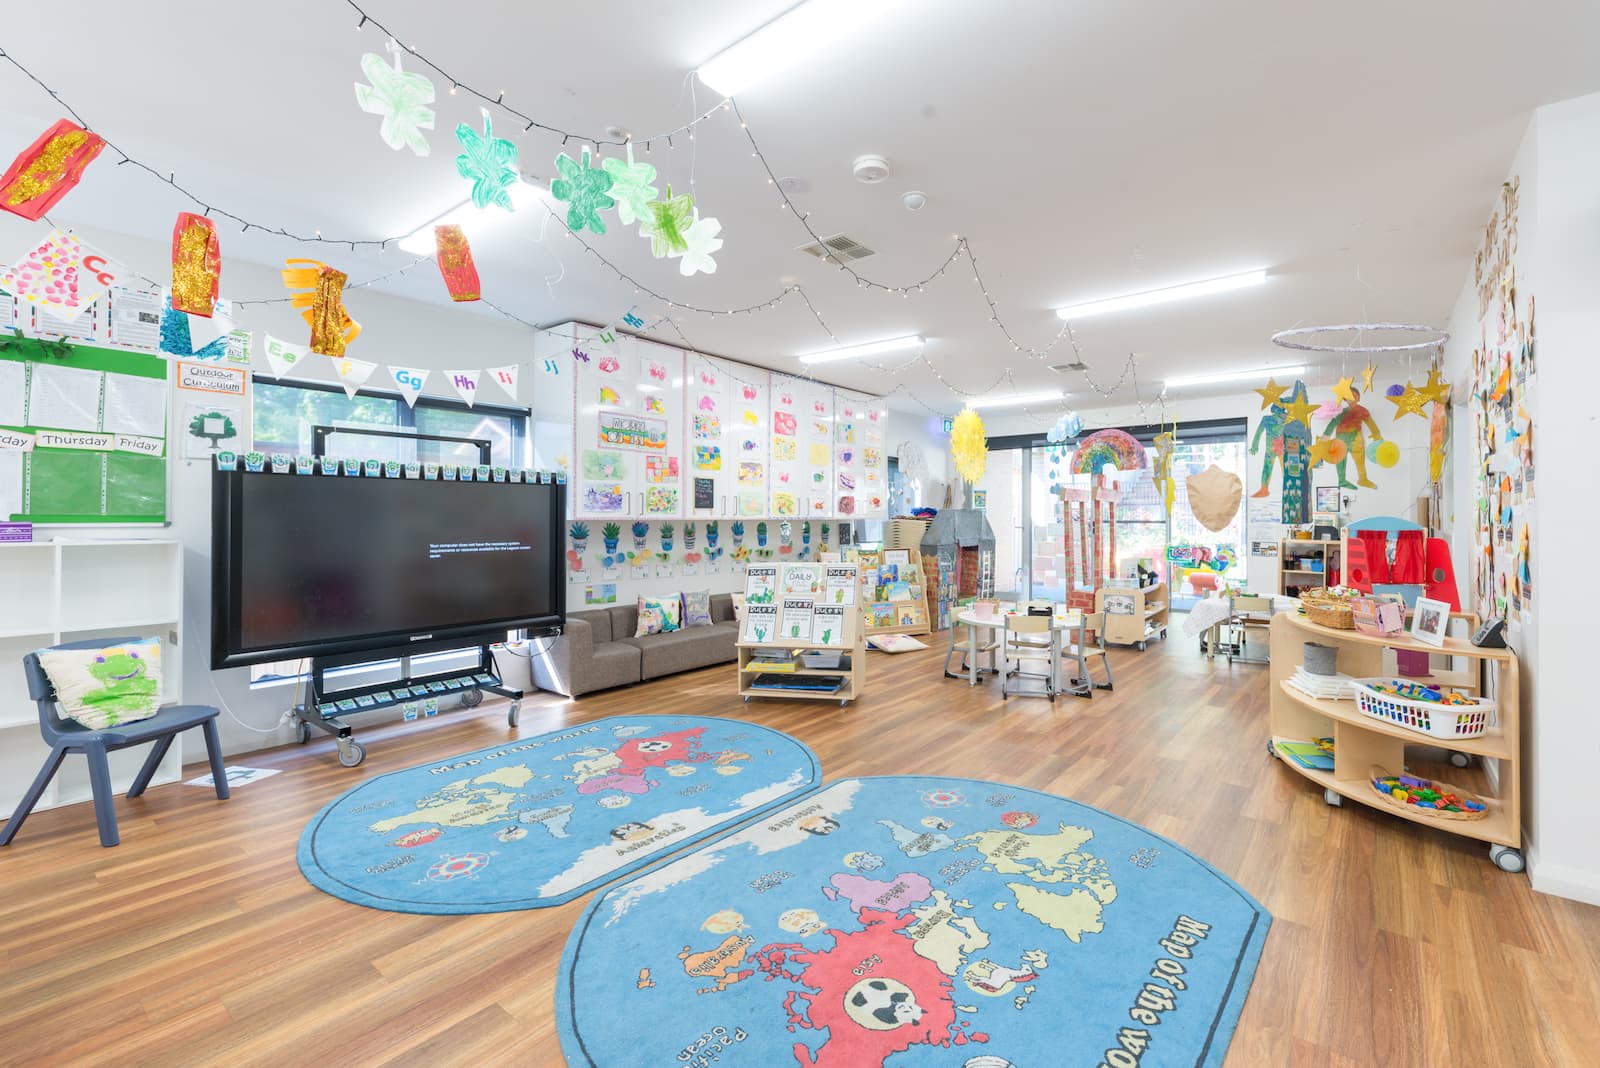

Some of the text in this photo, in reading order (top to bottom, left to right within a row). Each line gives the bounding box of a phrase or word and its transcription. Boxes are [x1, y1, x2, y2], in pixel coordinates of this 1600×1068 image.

[82, 255, 115, 286] Cc
[268, 341, 297, 364] Ee
[396, 371, 422, 390] Gg
[454, 375, 475, 390] Hh
[0, 435, 28, 447] day
[43, 435, 108, 446] Thursday
[119, 438, 158, 451] Friday
[789, 573, 812, 581] DAILY
[429, 758, 481, 776] Map
[1158, 913, 1213, 960] Map
[689, 935, 756, 976] Australia
[852, 953, 882, 976] Asia
[1150, 957, 1188, 991] of
[1129, 982, 1177, 1026] the
[676, 1026, 727, 1061] Ocean
[682, 1027, 749, 1068] Pacifi
